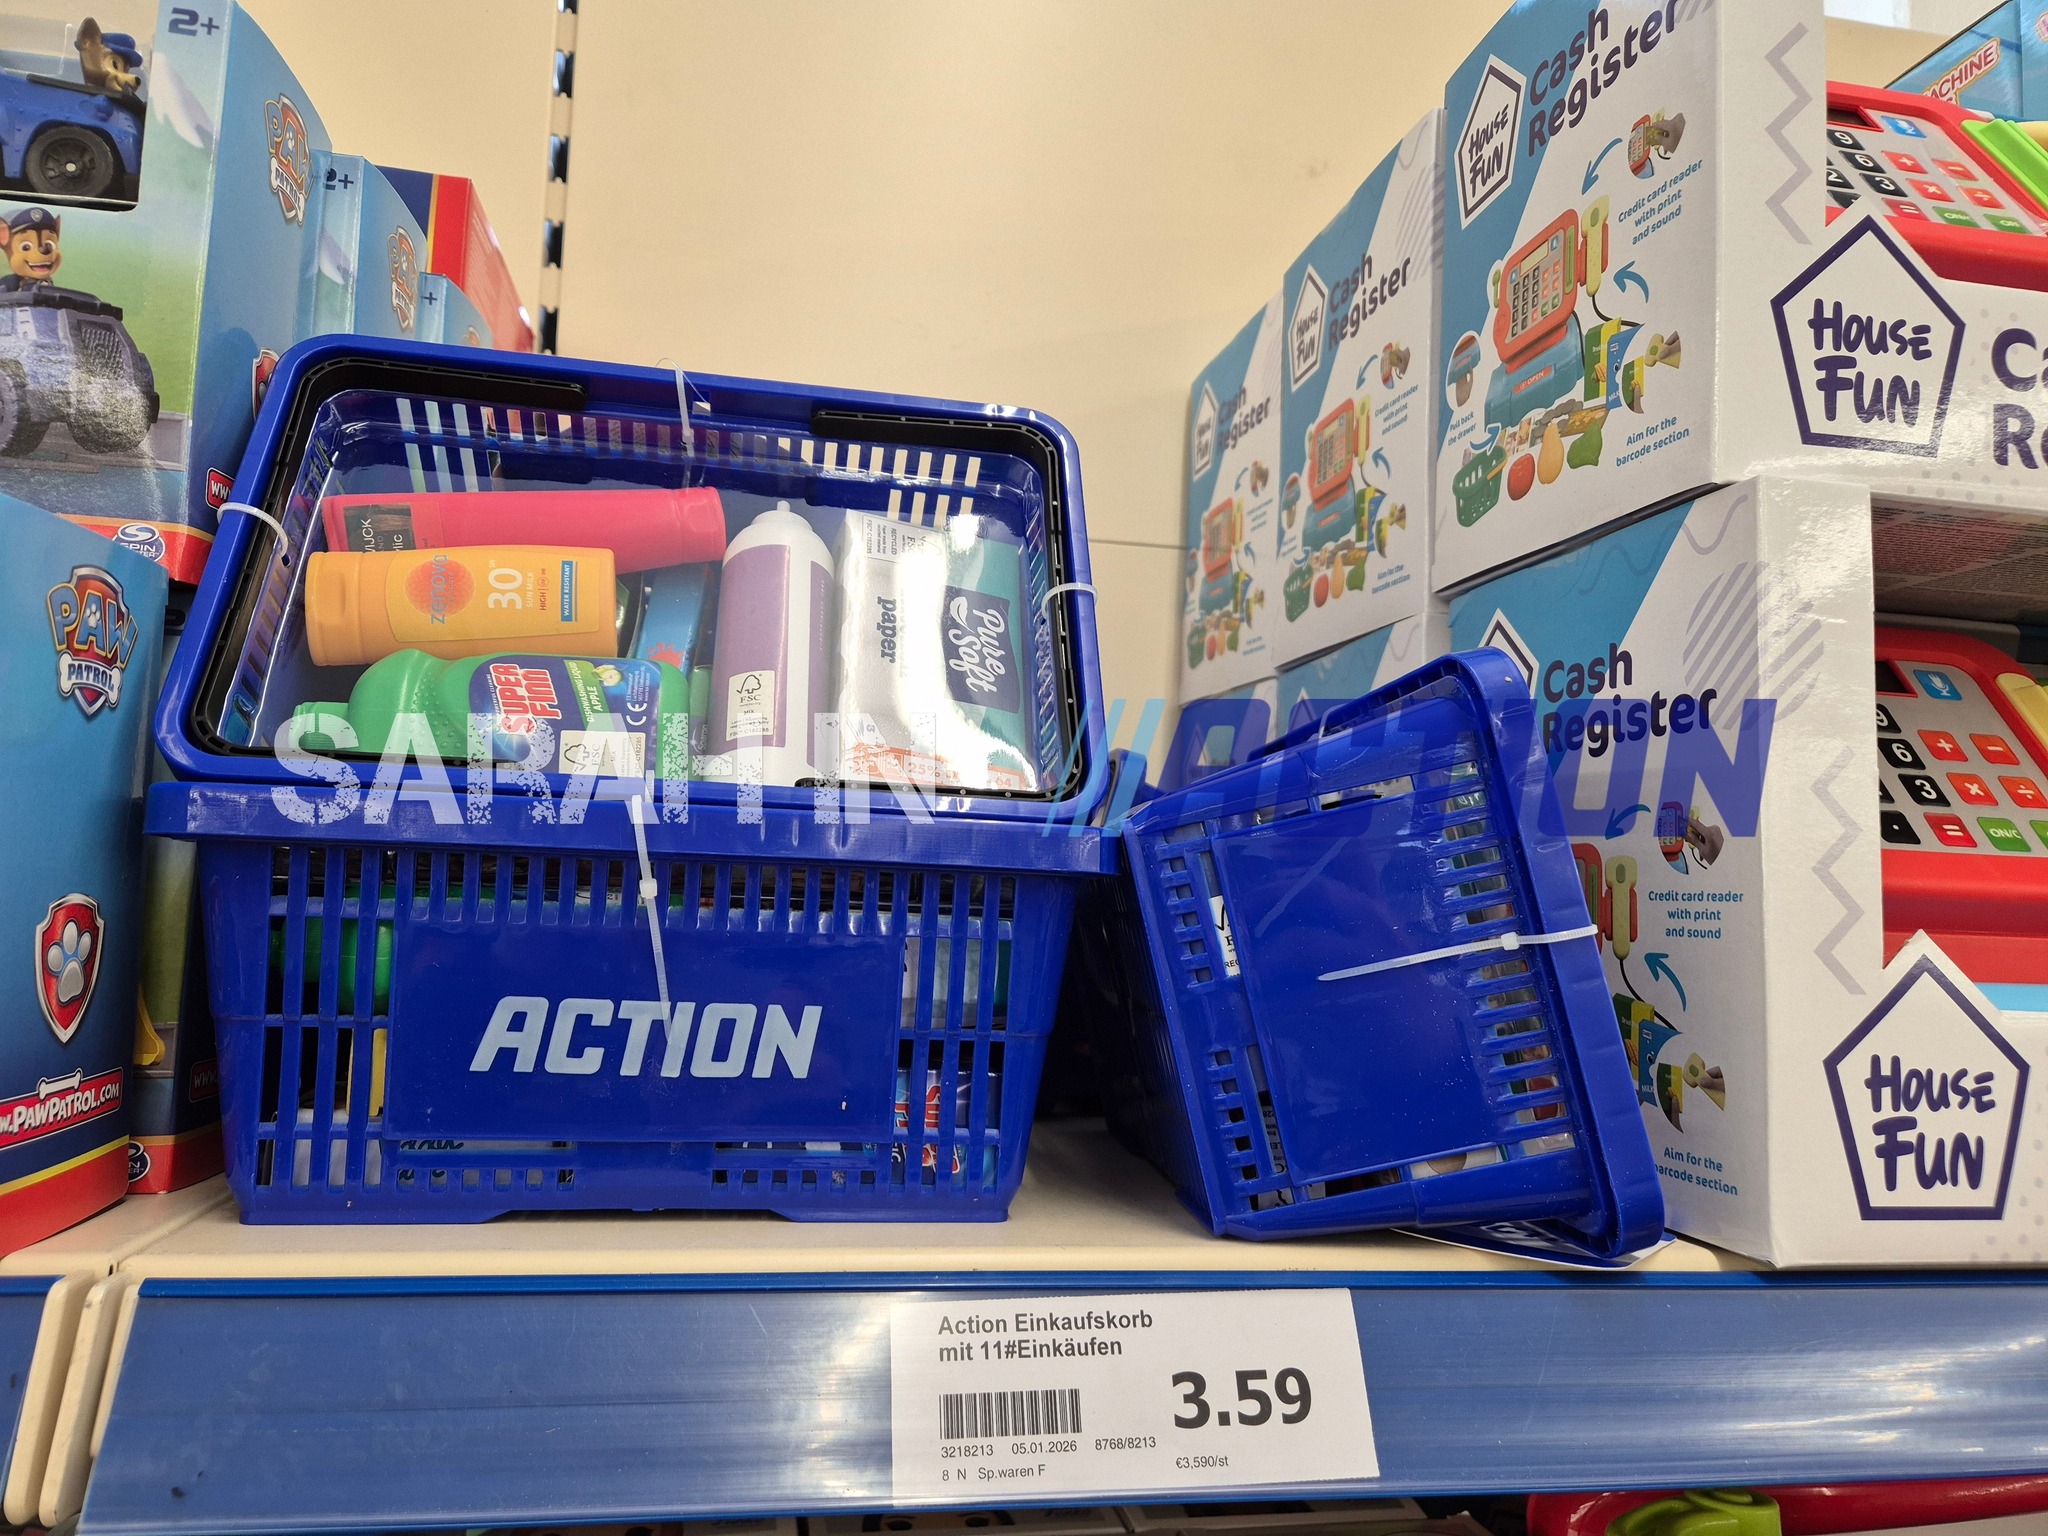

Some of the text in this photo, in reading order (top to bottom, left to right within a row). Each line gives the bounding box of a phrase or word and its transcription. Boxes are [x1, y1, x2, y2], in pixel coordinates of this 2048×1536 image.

[168, 7, 219, 36] 2+
[1530, 8, 1608, 106] Cash
[1925, 45, 1994, 98] ACHINE
[1528, 0, 1678, 157] Register
[1618, 159, 1702, 222] Credit card reader
[1634, 189, 1682, 228] with print
[1632, 205, 1682, 246] and sound
[1327, 257, 1410, 351] Register
[1329, 252, 1373, 316] Cash
[1807, 299, 1932, 360] HOUSE
[1813, 356, 1920, 428] FUN
[1616, 427, 1690, 467] barcode section
[1626, 415, 1678, 447] Aim for the
[487, 567, 523, 609] 30
[47, 583, 139, 669] PAW
[877, 596, 897, 663] paper
[67, 663, 115, 693] PATROL
[1542, 642, 1633, 703] Cash
[491, 664, 535, 733] SUPER
[573, 679, 595, 723] DISHWASHING
[585, 686, 604, 711] APPLE
[1542, 687, 1717, 758] Register
[1891, 743, 1912, 762] 6
[1914, 779, 1937, 800] 3
[1989, 827, 2023, 840] ON/C
[1648, 890, 1744, 902] Credit card reader
[1667, 908, 1721, 922] with print
[1665, 926, 1721, 939] and sound
[469, 996, 822, 1080] ACTION
[1864, 1054, 1996, 1113] HOUSE
[1664, 1147, 1723, 1172] Aim for the
[1872, 1116, 1983, 1191] FUN
[1696, 1176, 1738, 1196] section
[938, 1309, 1153, 1336] Action Einkaufskorb
[939, 1337, 1123, 1362] mit 11#Einkäufen
[1171, 1367, 1312, 1429] 3.59
[941, 1436, 1157, 1459] 3218213 05.01.2026 8768/8213
[1176, 1455, 1229, 1471] €3,590/st
[942, 1464, 1046, 1482] 8 N Sp.waren F
